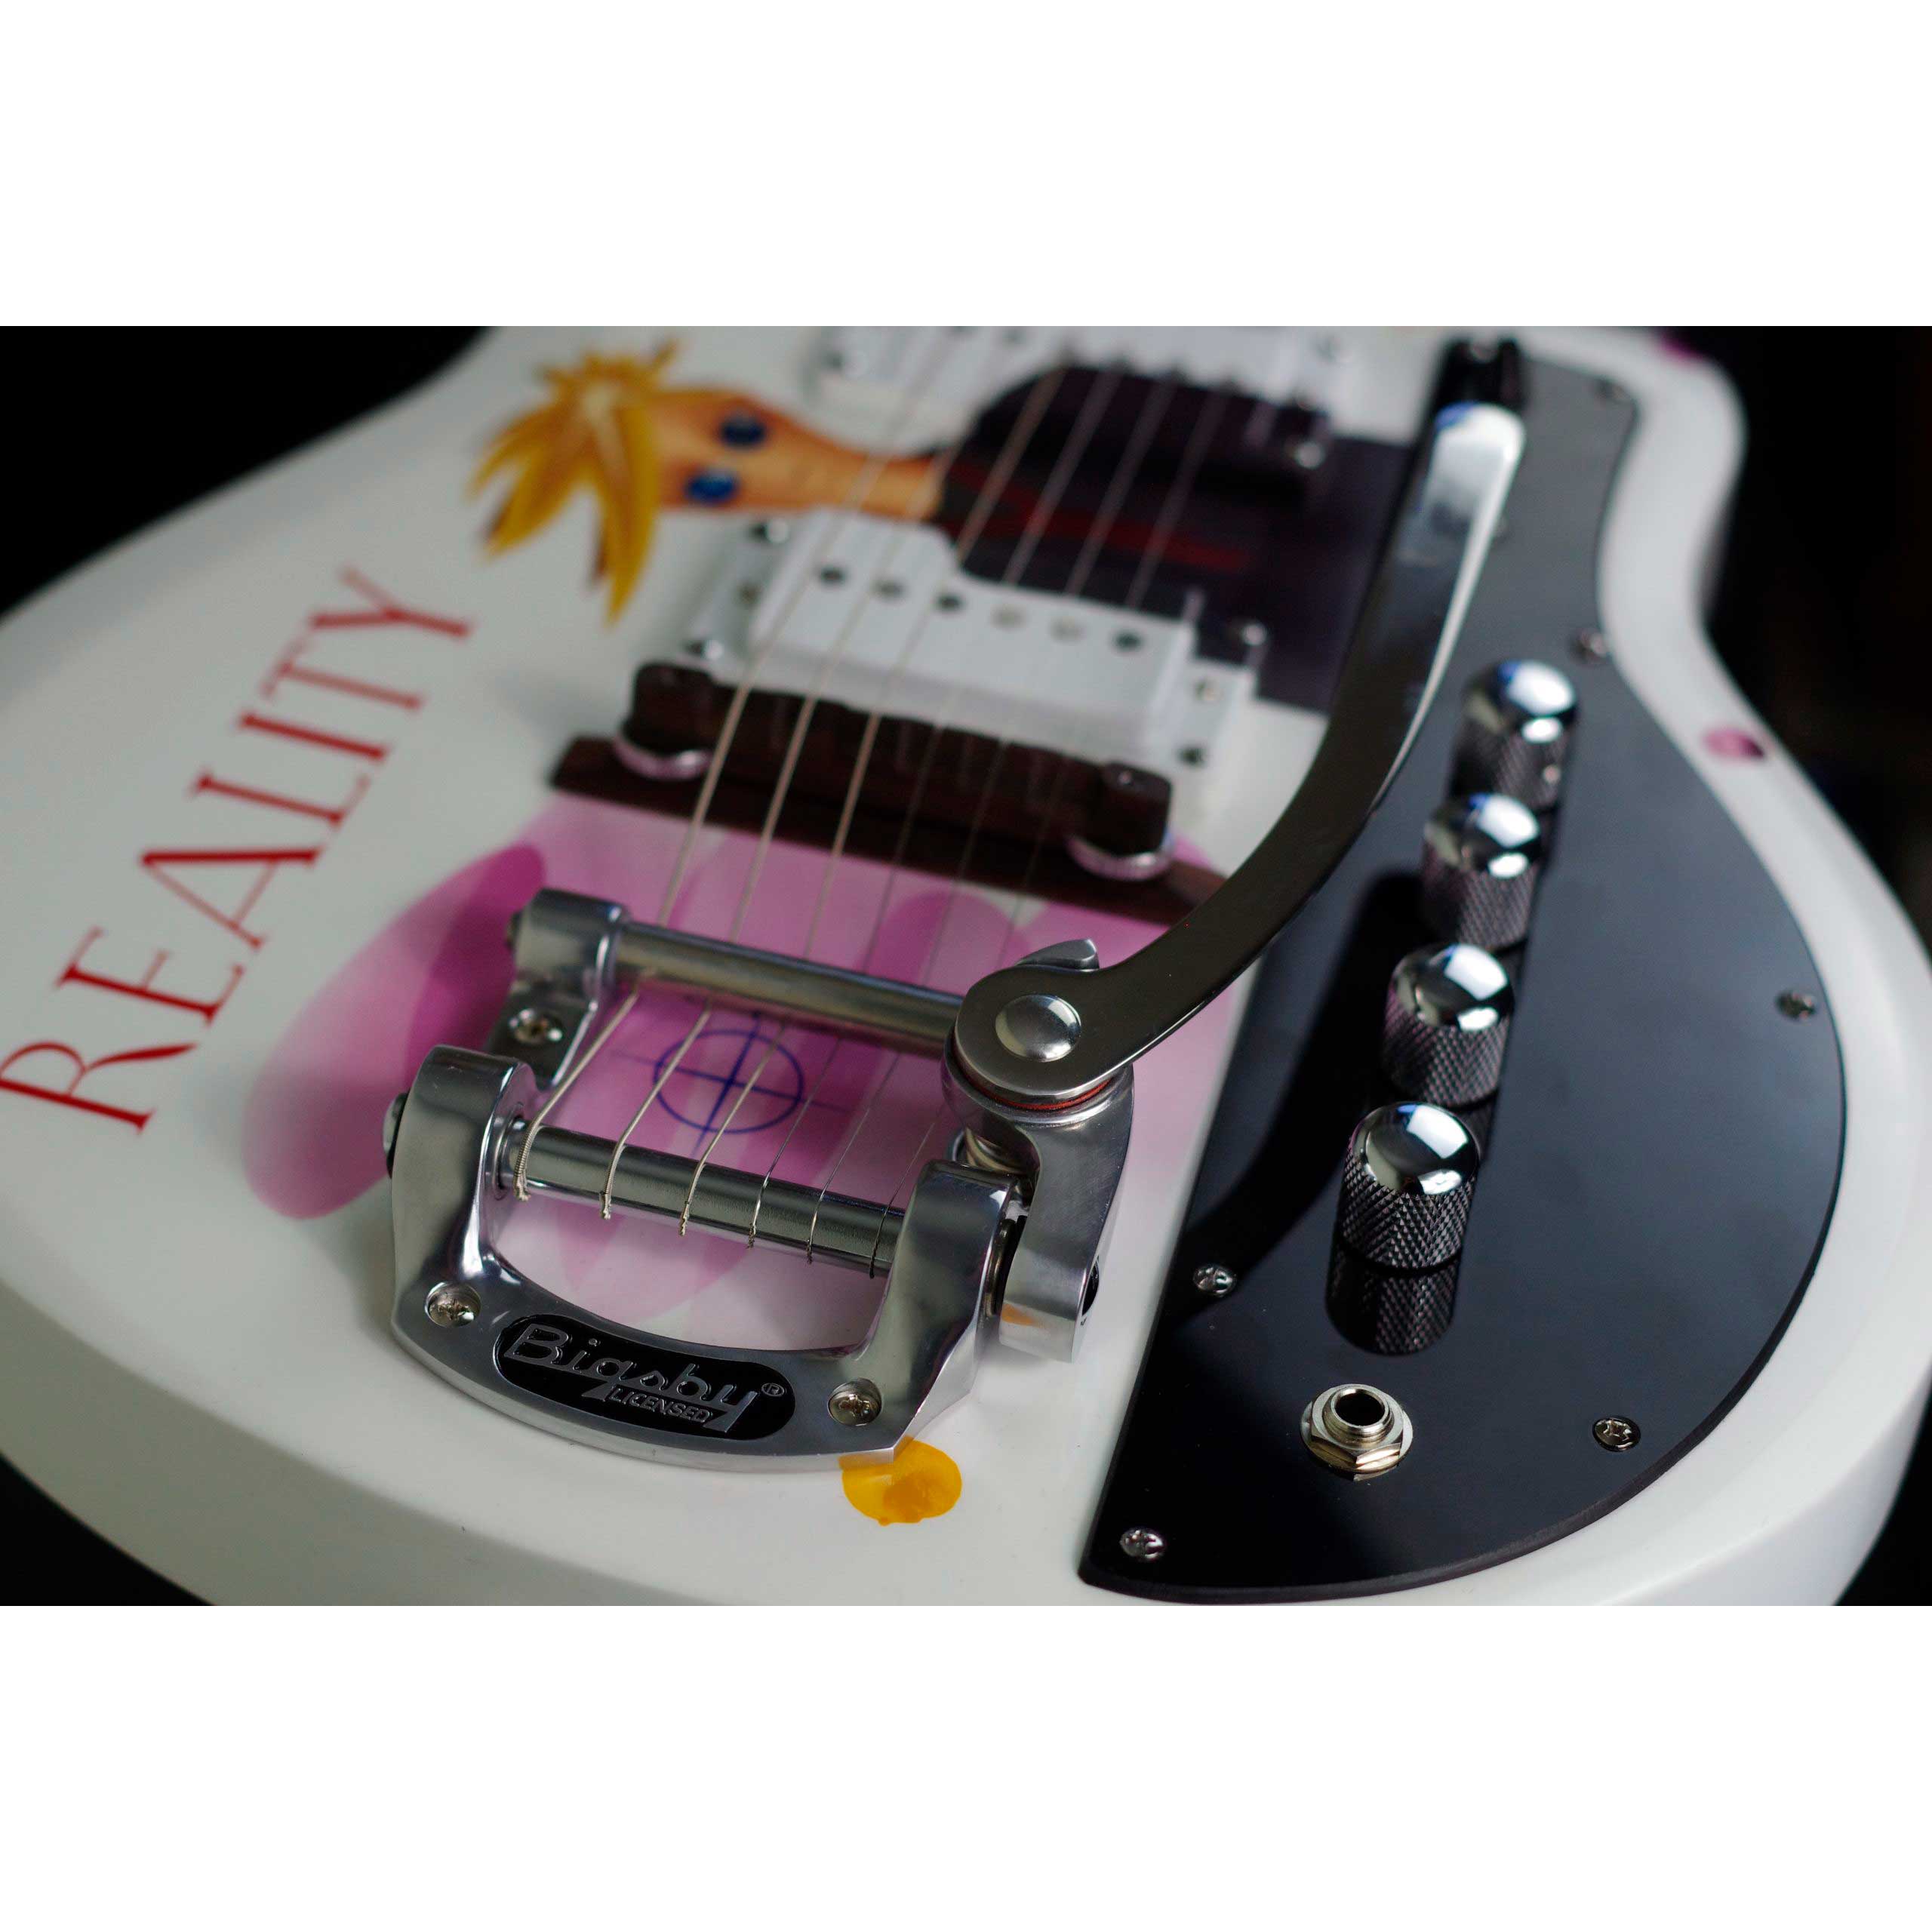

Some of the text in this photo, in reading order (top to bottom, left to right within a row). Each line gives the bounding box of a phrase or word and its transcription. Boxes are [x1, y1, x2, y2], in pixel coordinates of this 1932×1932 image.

[0, 566, 472, 1134] REALITY
[503, 1324, 758, 1433] Bigsby
[609, 1386, 714, 1424] LICENSED
